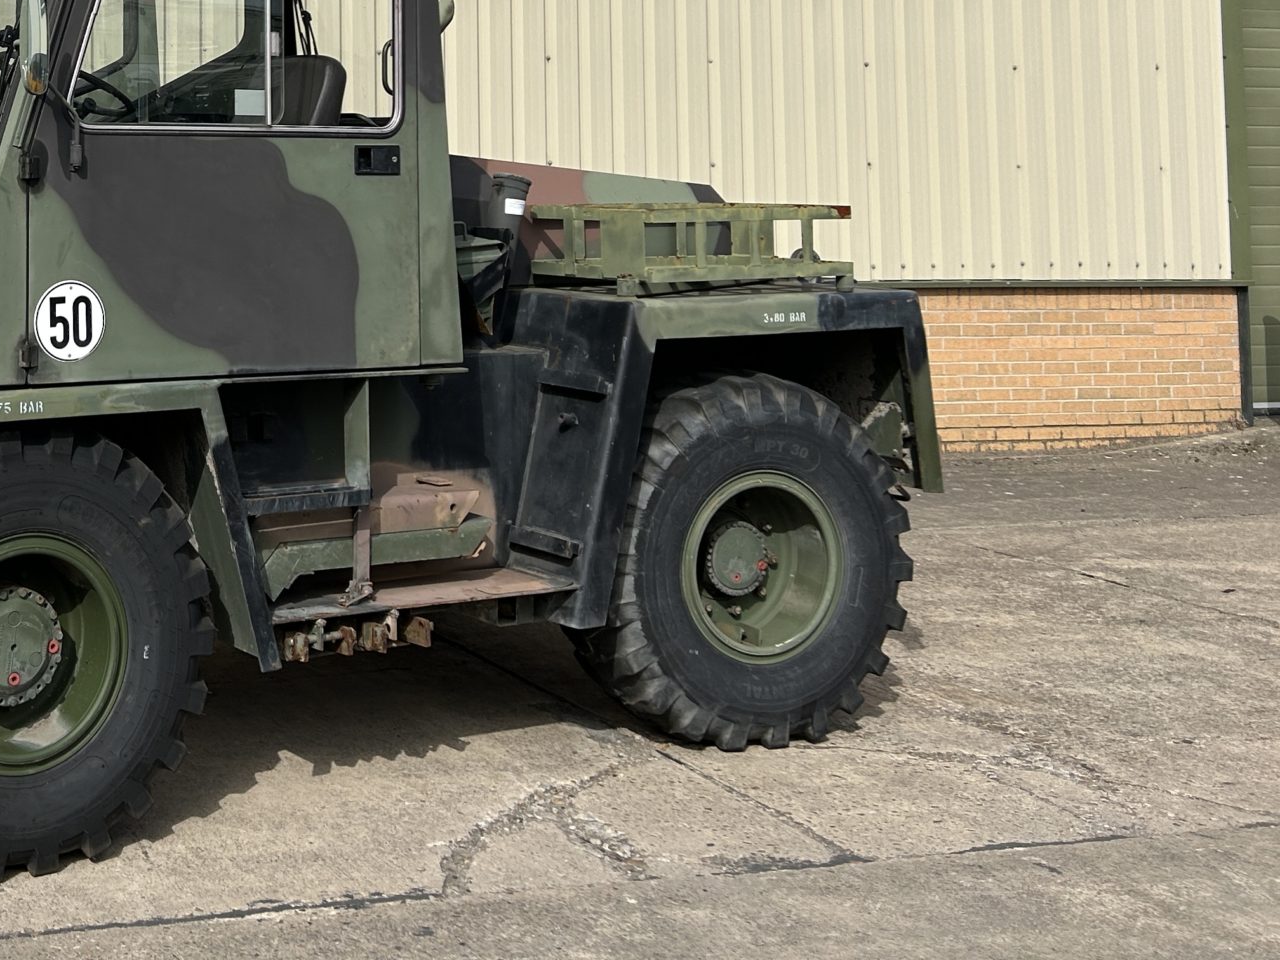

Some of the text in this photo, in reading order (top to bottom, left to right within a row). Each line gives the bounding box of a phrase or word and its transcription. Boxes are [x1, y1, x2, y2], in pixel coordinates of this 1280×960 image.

[49, 295, 93, 349] 50
[789, 311, 807, 322] BAR
[20, 400, 43, 414] BAR
